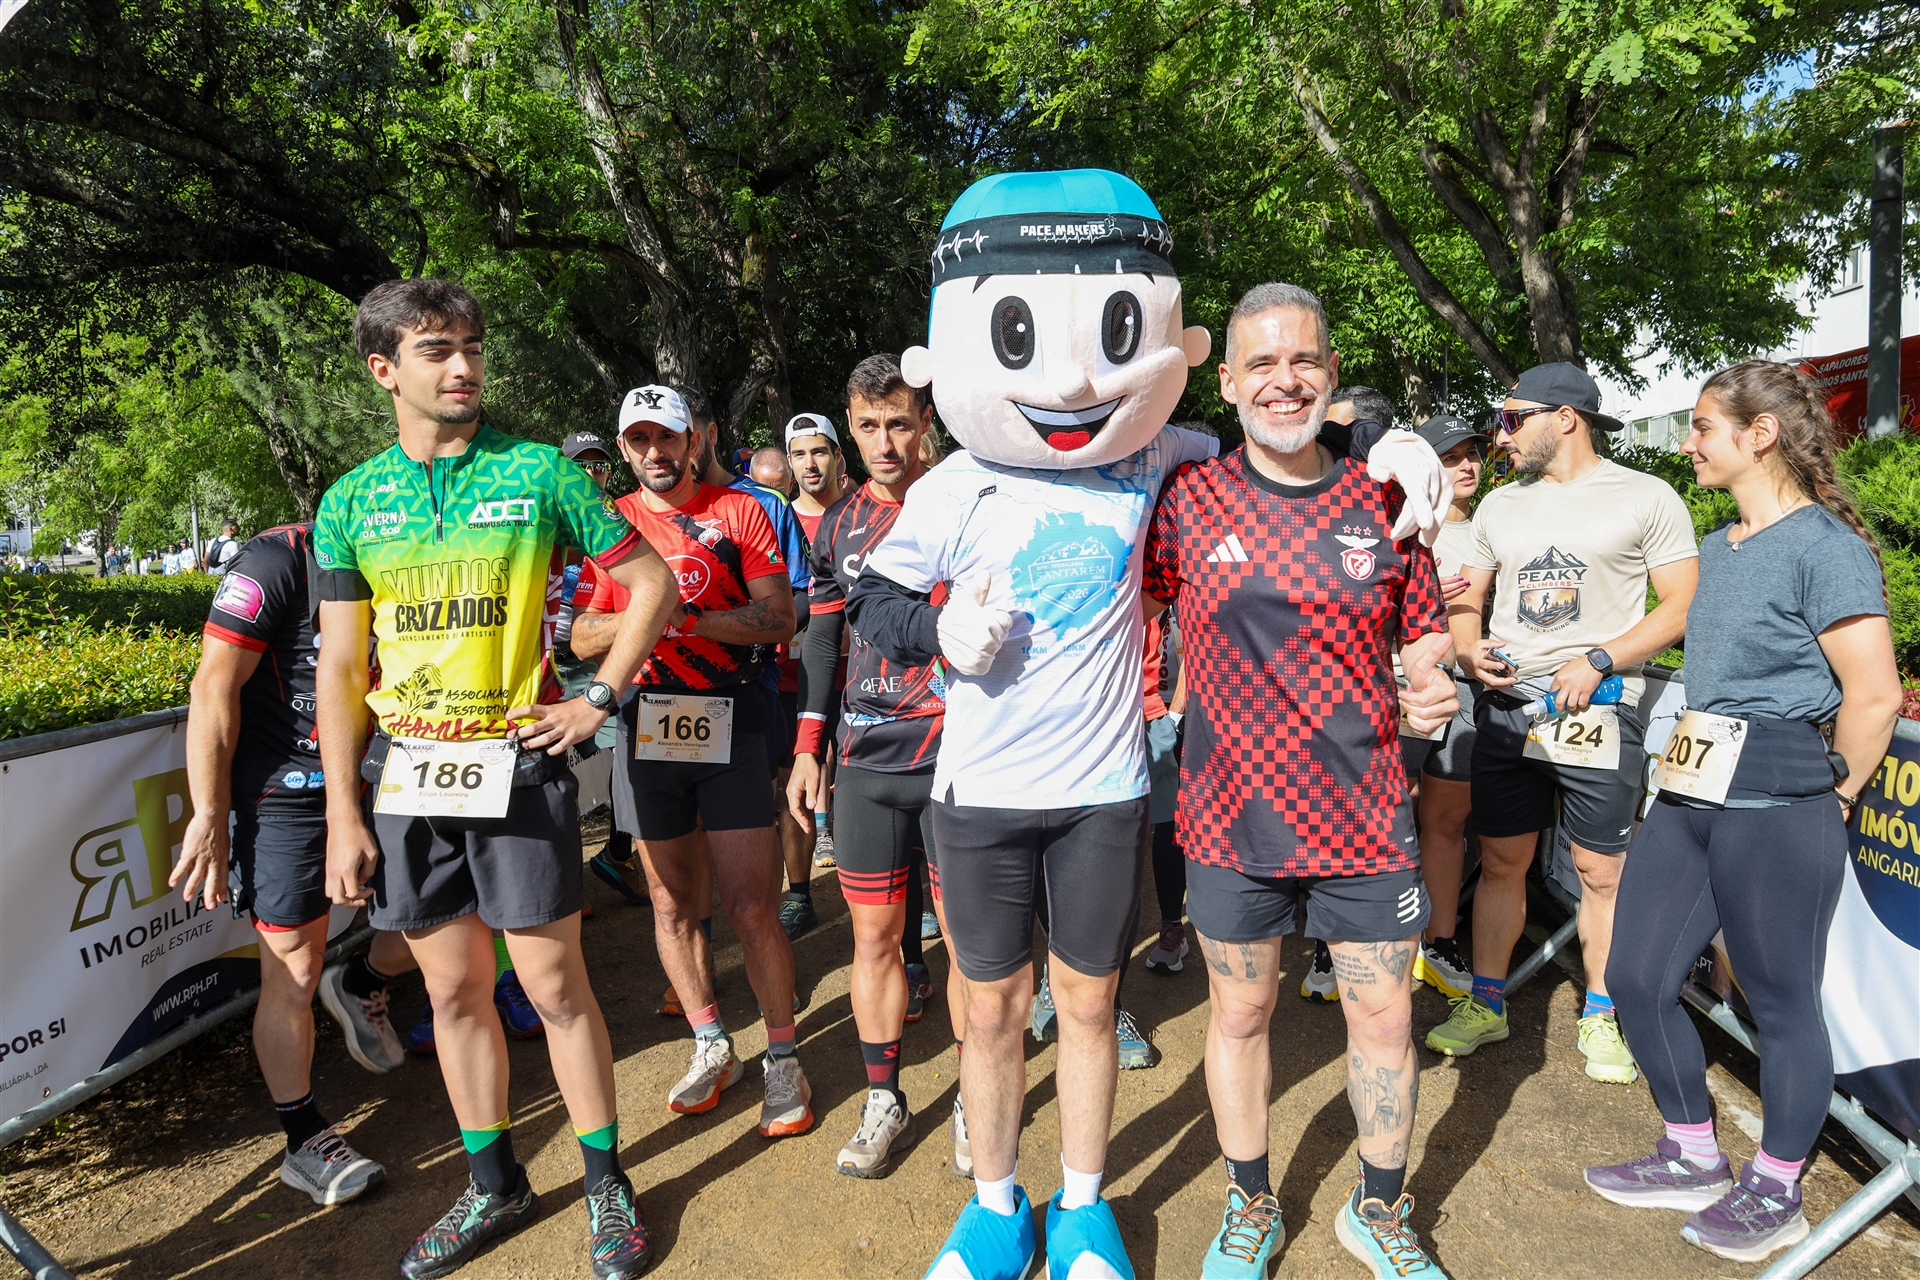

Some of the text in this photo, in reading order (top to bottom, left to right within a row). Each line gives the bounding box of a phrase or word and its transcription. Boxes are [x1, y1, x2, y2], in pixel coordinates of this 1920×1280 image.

[1819, 353, 1868, 374] SAPADORES
[634, 389, 665, 410] NY
[362, 526, 400, 538] DA COR
[468, 519, 535, 529] CHAMUSCA TRAIL
[380, 557, 510, 603] MUNDOS
[1036, 563, 1106, 581] SANTARÉM
[1518, 569, 1588, 584] PEAKY
[1061, 588, 1089, 600] 2026
[1526, 581, 1572, 589] CLIMBERS
[395, 596, 508, 633] CRUZADOS
[398, 633, 450, 642] AGENCIAMENTO
[461, 630, 497, 638] ARTISTAS
[1523, 621, 1570, 633] TRAIL RUNNING
[445, 685, 510, 701] ASSOCIAÇÃO
[658, 714, 711, 742] 166
[1550, 718, 1603, 748] 124
[1665, 733, 1715, 770] 207
[413, 761, 484, 790] 186
[1857, 844, 1920, 889] ANGARI
[141, 919, 213, 968] REAL ESTATE
[152, 972, 219, 1022] WWW.RPH.PT
[48, 1016, 66, 1039] SI
[33, 1062, 49, 1076] LDA
